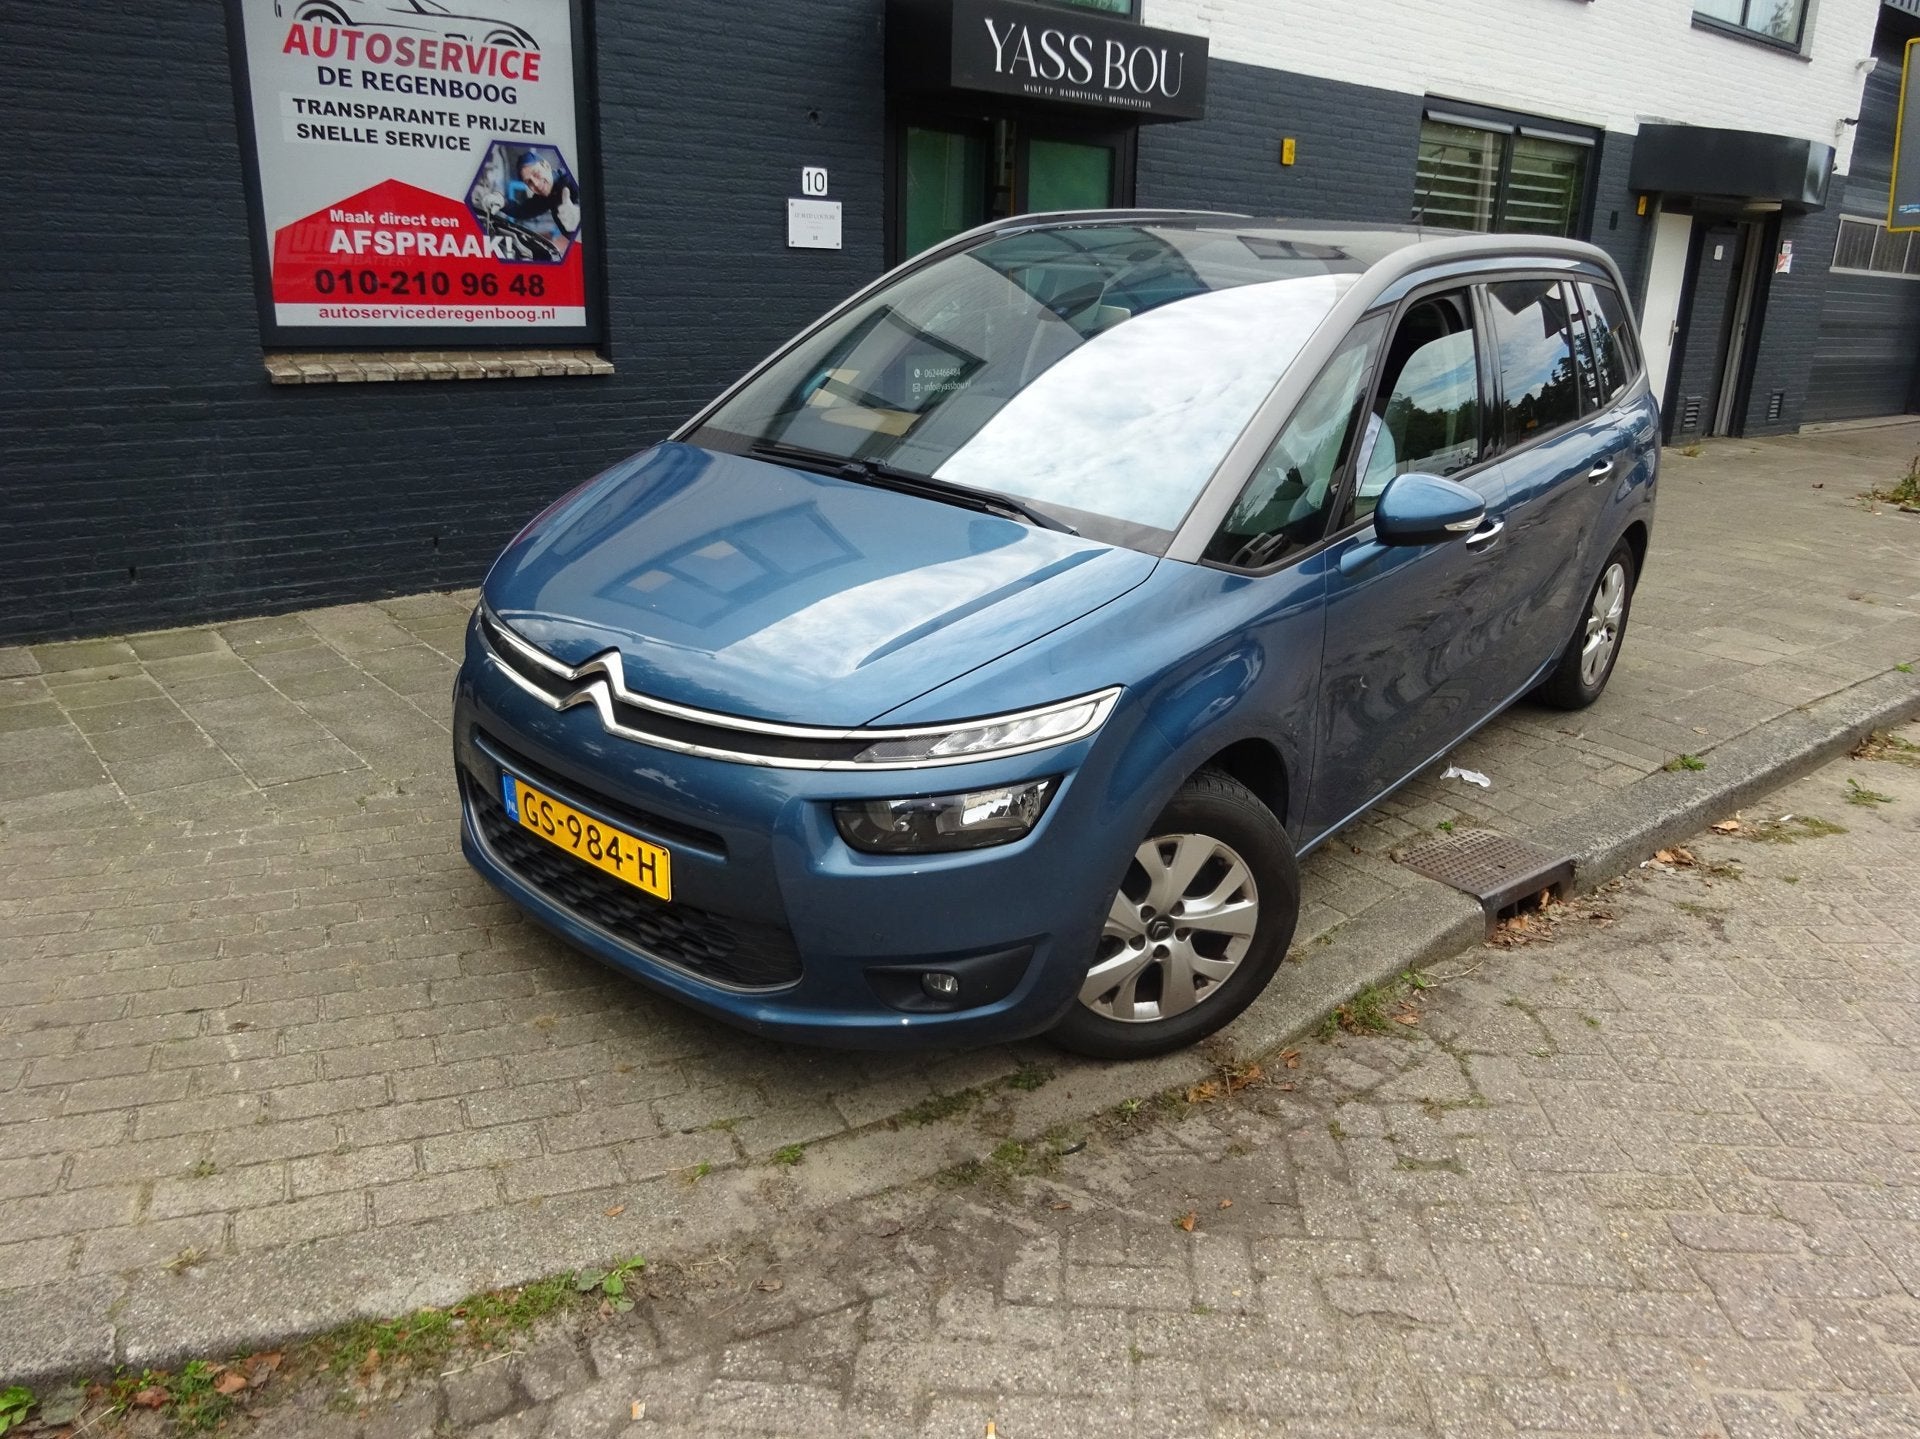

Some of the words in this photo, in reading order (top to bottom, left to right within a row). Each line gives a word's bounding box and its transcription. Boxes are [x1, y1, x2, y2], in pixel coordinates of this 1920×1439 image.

[282, 23, 541, 82] AUTOSERVICE
[984, 17, 1093, 84] YASS
[1103, 39, 1184, 98] BOU
[317, 65, 353, 89] DE
[362, 70, 518, 105] REGENBOOG
[292, 98, 460, 128] TRANSPARANTE
[467, 114, 546, 136] PRIJZEN
[296, 123, 378, 145] SNELLE
[385, 131, 471, 152] SERVICE
[806, 171, 825, 192] 10
[329, 209, 375, 225] Maak
[379, 211, 428, 228] direct
[431, 215, 460, 228] een
[329, 229, 515, 260] AFSPRAAK!
[314, 269, 451, 297] 010-210
[461, 273, 499, 297] 96
[509, 274, 545, 297] 48
[318, 306, 556, 322] autoservicederegenboog.nl
[523, 791, 657, 888] GS-984-H
